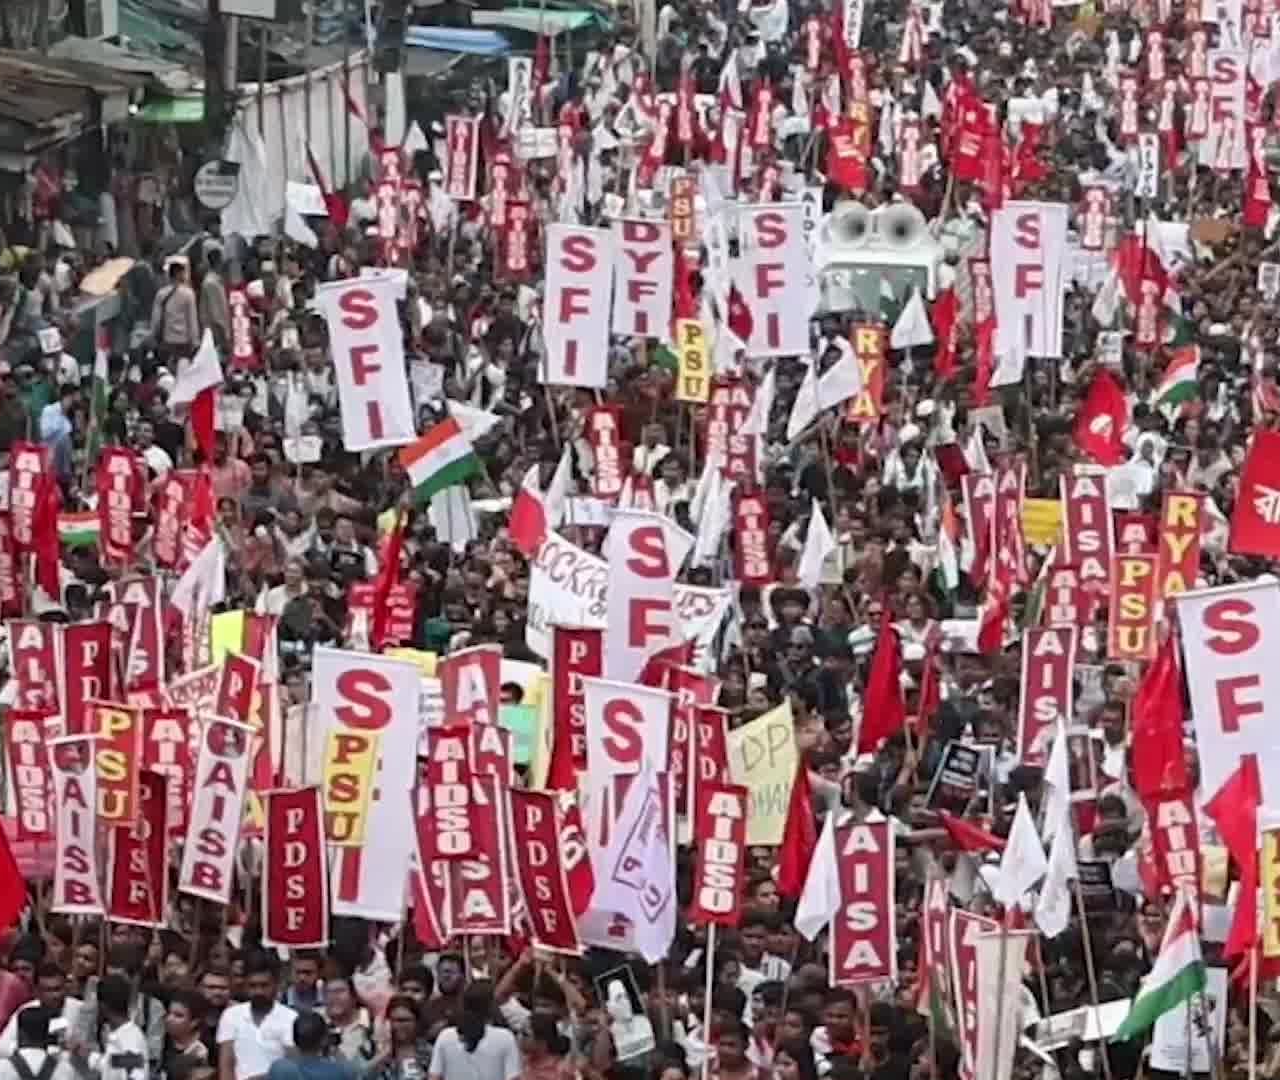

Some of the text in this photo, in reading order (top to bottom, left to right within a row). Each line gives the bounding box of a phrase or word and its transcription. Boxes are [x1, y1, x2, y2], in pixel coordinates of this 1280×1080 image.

[560, 235, 596, 376] SFI
[622, 221, 662, 334] DYFI
[754, 212, 788, 348] SFI
[1016, 213, 1043, 348] SFI
[338, 290, 385, 440] SFI
[683, 323, 704, 397] PSU
[592, 411, 623, 494] AIDSO
[736, 497, 769, 580] AIDSO
[1071, 478, 1107, 579] AISA
[1163, 495, 1198, 598] RYA
[1116, 560, 1150, 651] PSU
[568, 640, 588, 757] PDSF
[11, 720, 48, 832] AIDSO
[95, 707, 131, 819] PSU
[325, 734, 369, 842] PSU
[433, 737, 473, 856] AIDSO
[62, 776, 97, 906] AISB
[191, 761, 237, 890] AISB
[283, 806, 308, 932] PDSF
[525, 806, 559, 933] PDSF
[699, 791, 742, 913] AIDSO
[843, 826, 882, 968] AISA
